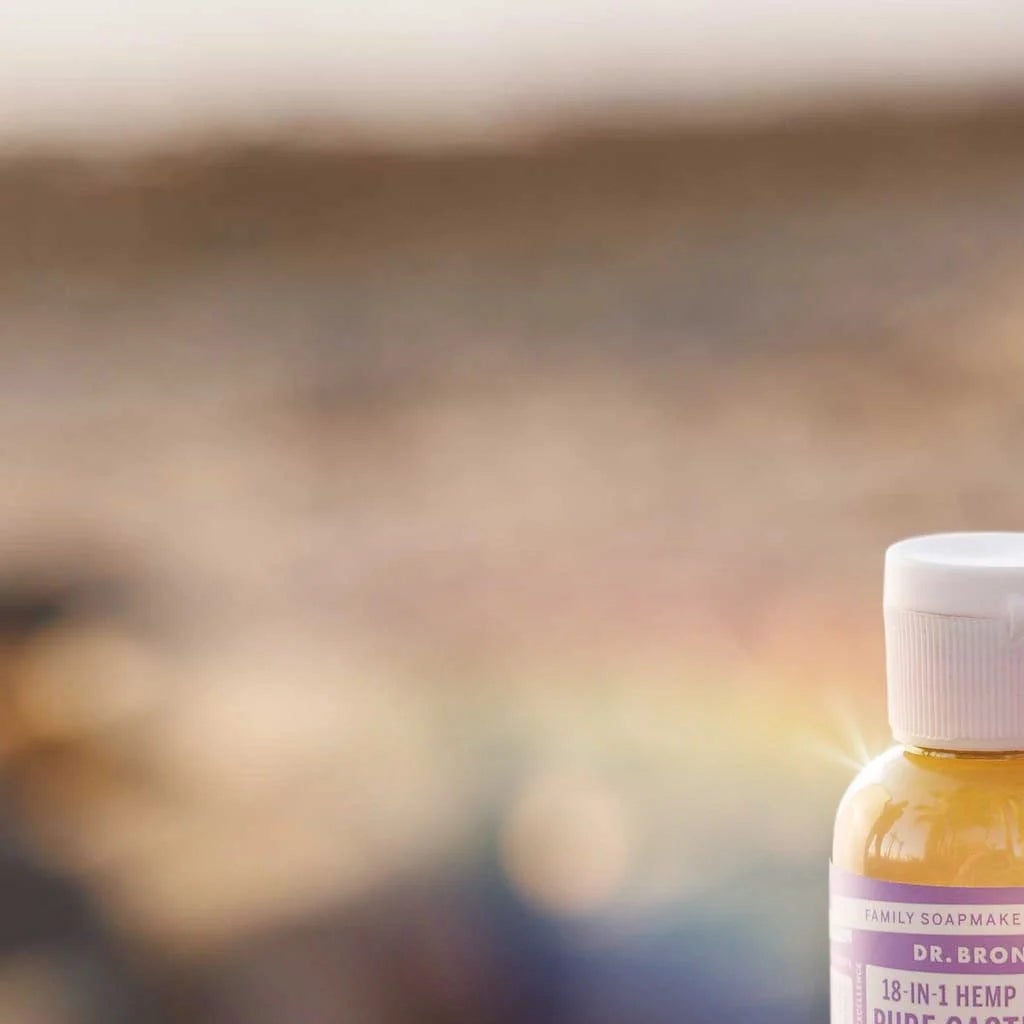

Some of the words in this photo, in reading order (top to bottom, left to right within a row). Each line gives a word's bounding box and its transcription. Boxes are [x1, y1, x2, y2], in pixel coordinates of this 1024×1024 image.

[865, 909, 914, 924] FAMILY
[913, 944, 952, 963] DR.
[882, 978, 948, 1007] 18-IN-1
[956, 985, 1017, 1008] HEMP
